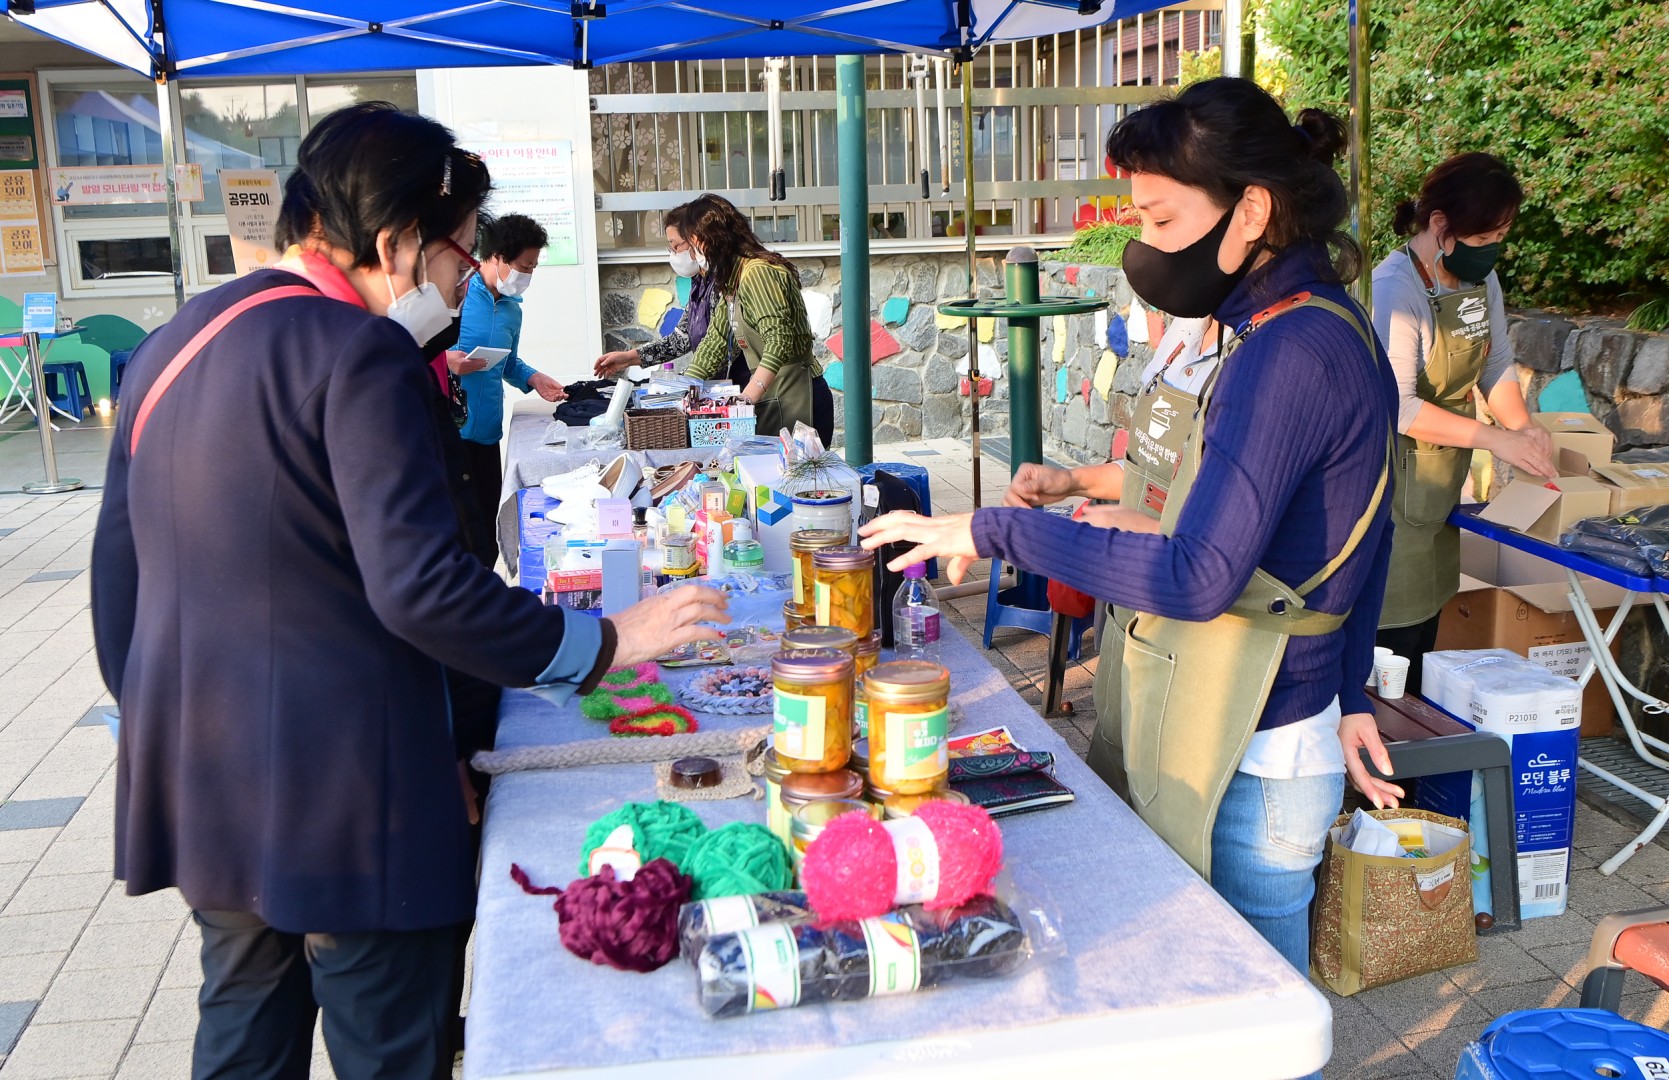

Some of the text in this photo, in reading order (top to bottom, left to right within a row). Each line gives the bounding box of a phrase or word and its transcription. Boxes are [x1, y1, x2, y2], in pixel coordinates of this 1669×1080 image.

[514, 147, 557, 159] 이용안내
[4, 175, 24, 186] 공유
[5, 186, 26, 196] 모이
[102, 183, 139, 194] 모니터링
[228, 192, 270, 206] 공유모이
[11, 229, 31, 239] 공유
[12, 239, 33, 250] 모이
[1508, 713, 1538, 722] P21010
[1519, 768, 1571, 786] 모던 블루
[1522, 785, 1567, 796] Modern blue
